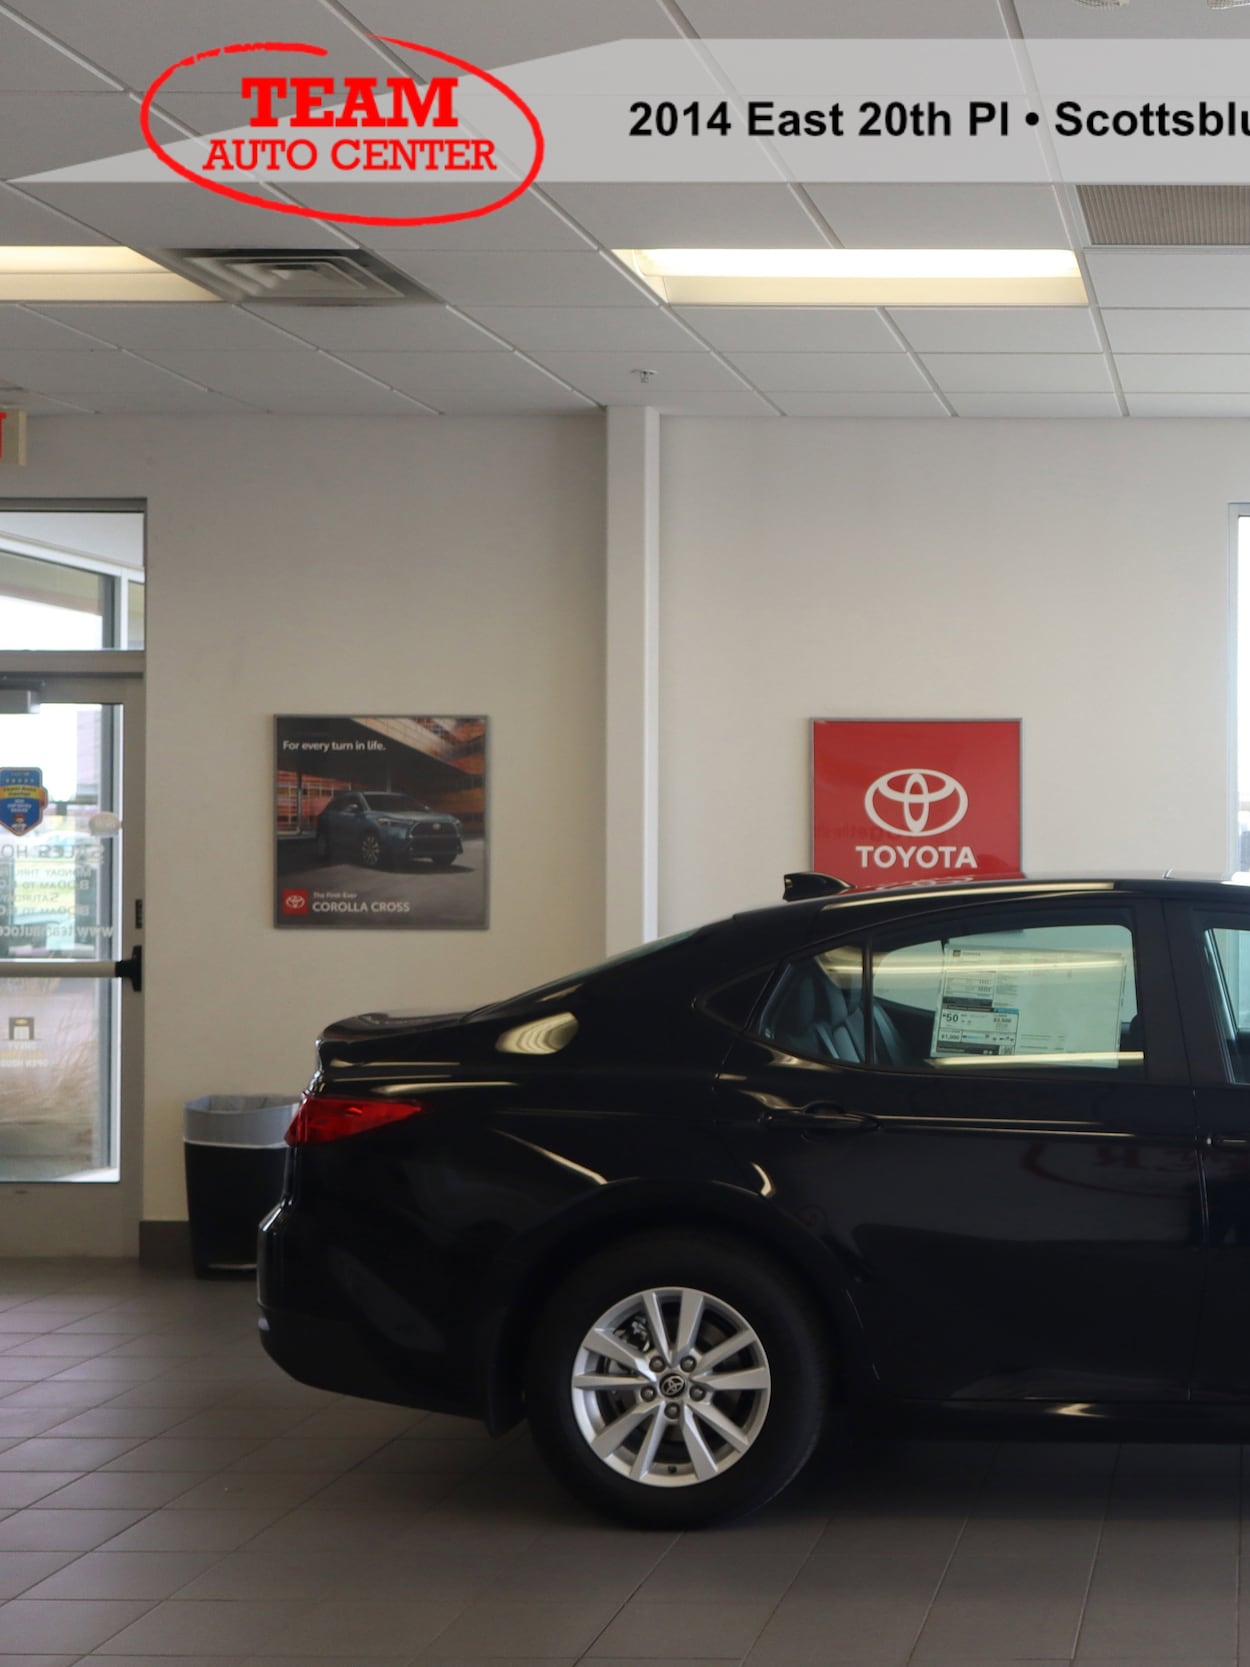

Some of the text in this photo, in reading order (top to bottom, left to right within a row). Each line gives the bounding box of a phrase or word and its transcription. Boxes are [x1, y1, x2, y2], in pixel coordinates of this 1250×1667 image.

[283, 740, 387, 753] For every turn in life.
[855, 846, 978, 869] TOYOTA
[312, 902, 410, 913] COROLLA CROSS
